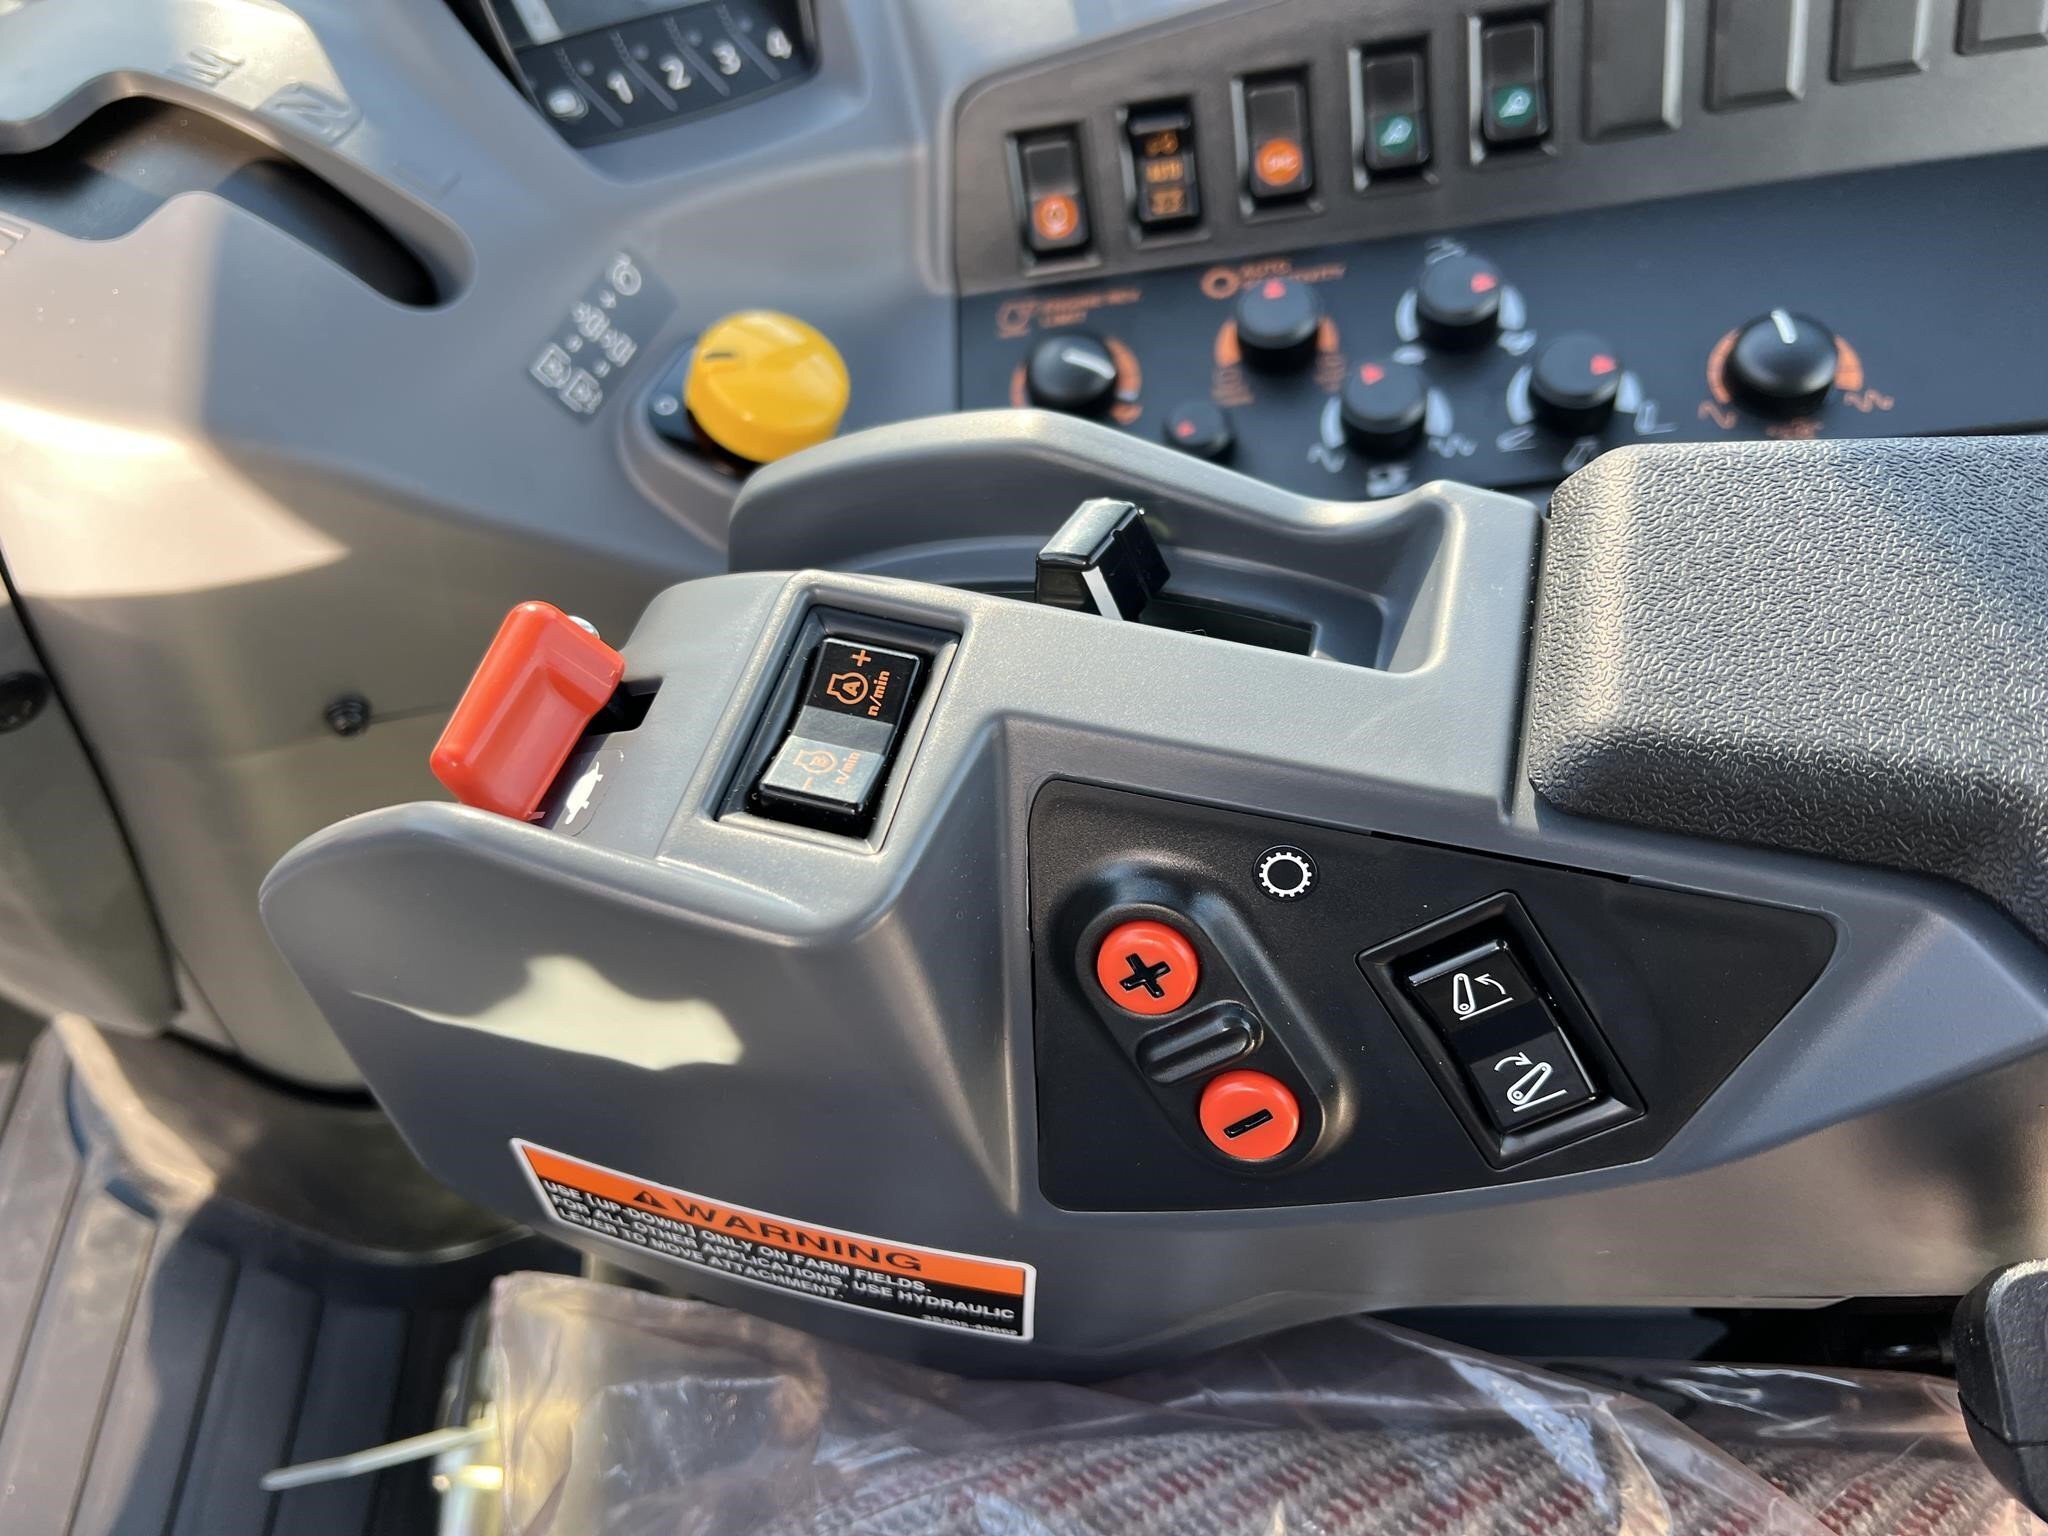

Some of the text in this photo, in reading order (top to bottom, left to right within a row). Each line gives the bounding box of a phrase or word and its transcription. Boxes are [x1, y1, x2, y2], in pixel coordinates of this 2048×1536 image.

[606, 70, 634, 104] 1
[659, 54, 692, 91] 2
[713, 40, 742, 76] 3
[867, 670, 890, 717] n/min
[541, 1179, 583, 1201] USE
[700, 1230, 753, 1253] ONLY
[757, 1245, 789, 1263] ON
[792, 1254, 850, 1276] FARM
[854, 1268, 932, 1293] FIELDS.
[550, 1193, 591, 1215] FOR
[592, 1208, 631, 1229] ALL
[631, 1220, 699, 1250] OTHER
[852, 1280, 894, 1299] USE
[899, 1290, 1015, 1320] HYDRAULIC
[557, 1207, 844, 1299] LEVER TO MOVE ATTACHMENT.
[672, 1197, 922, 1271] WARNING
